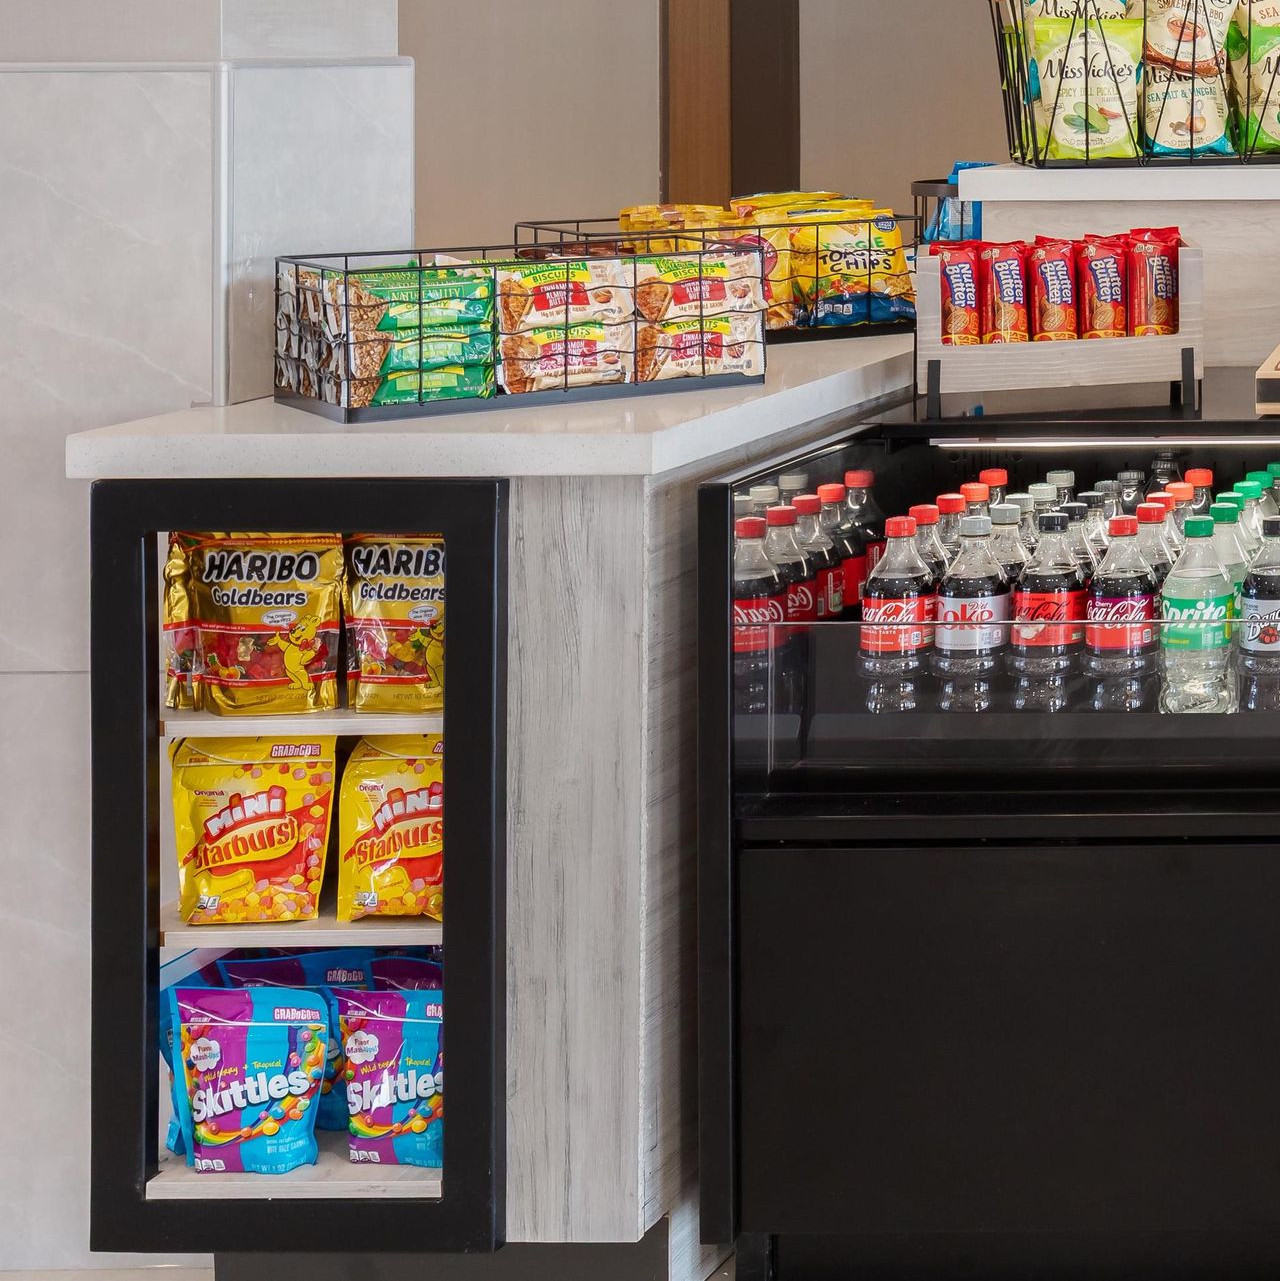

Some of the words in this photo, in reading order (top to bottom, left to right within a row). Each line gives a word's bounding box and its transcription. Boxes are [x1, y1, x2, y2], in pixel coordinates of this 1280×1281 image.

[1209, 8, 1225, 21] BBQ
[1259, 8, 1278, 20] SEA
[1147, 92, 1160, 103] SEA
[1181, 89, 1188, 99] &
[533, 270, 577, 283] BISCUITS
[829, 258, 893, 273] CHIPS
[1007, 259, 1024, 304] Nutter
[1053, 259, 1072, 304] Nutter
[1091, 259, 1111, 303] Butter
[1102, 257, 1122, 302] Nutter
[1149, 256, 1166, 299] Butter
[945, 265, 966, 308] Butter
[958, 263, 976, 308] Nutter
[994, 261, 1014, 304] Butter
[1041, 262, 1061, 304] Butter
[676, 320, 718, 331] BISCITS
[203, 550, 320, 583] HARIBO
[352, 546, 445, 579] HARIB
[212, 585, 308, 607] Goldbears
[968, 600, 988, 612] Diet
[1087, 598, 1150, 630] Coca-Cola
[1161, 600, 1227, 633] Sprite
[194, 789, 225, 797] Original
[197, 817, 298, 869] Starburst
[355, 819, 444, 867] Starburs
[251, 1061, 283, 1071] Tropical
[404, 1056, 432, 1068] Tropical
[193, 1069, 311, 1123] Skittles
[347, 1069, 444, 1116] Skttles
